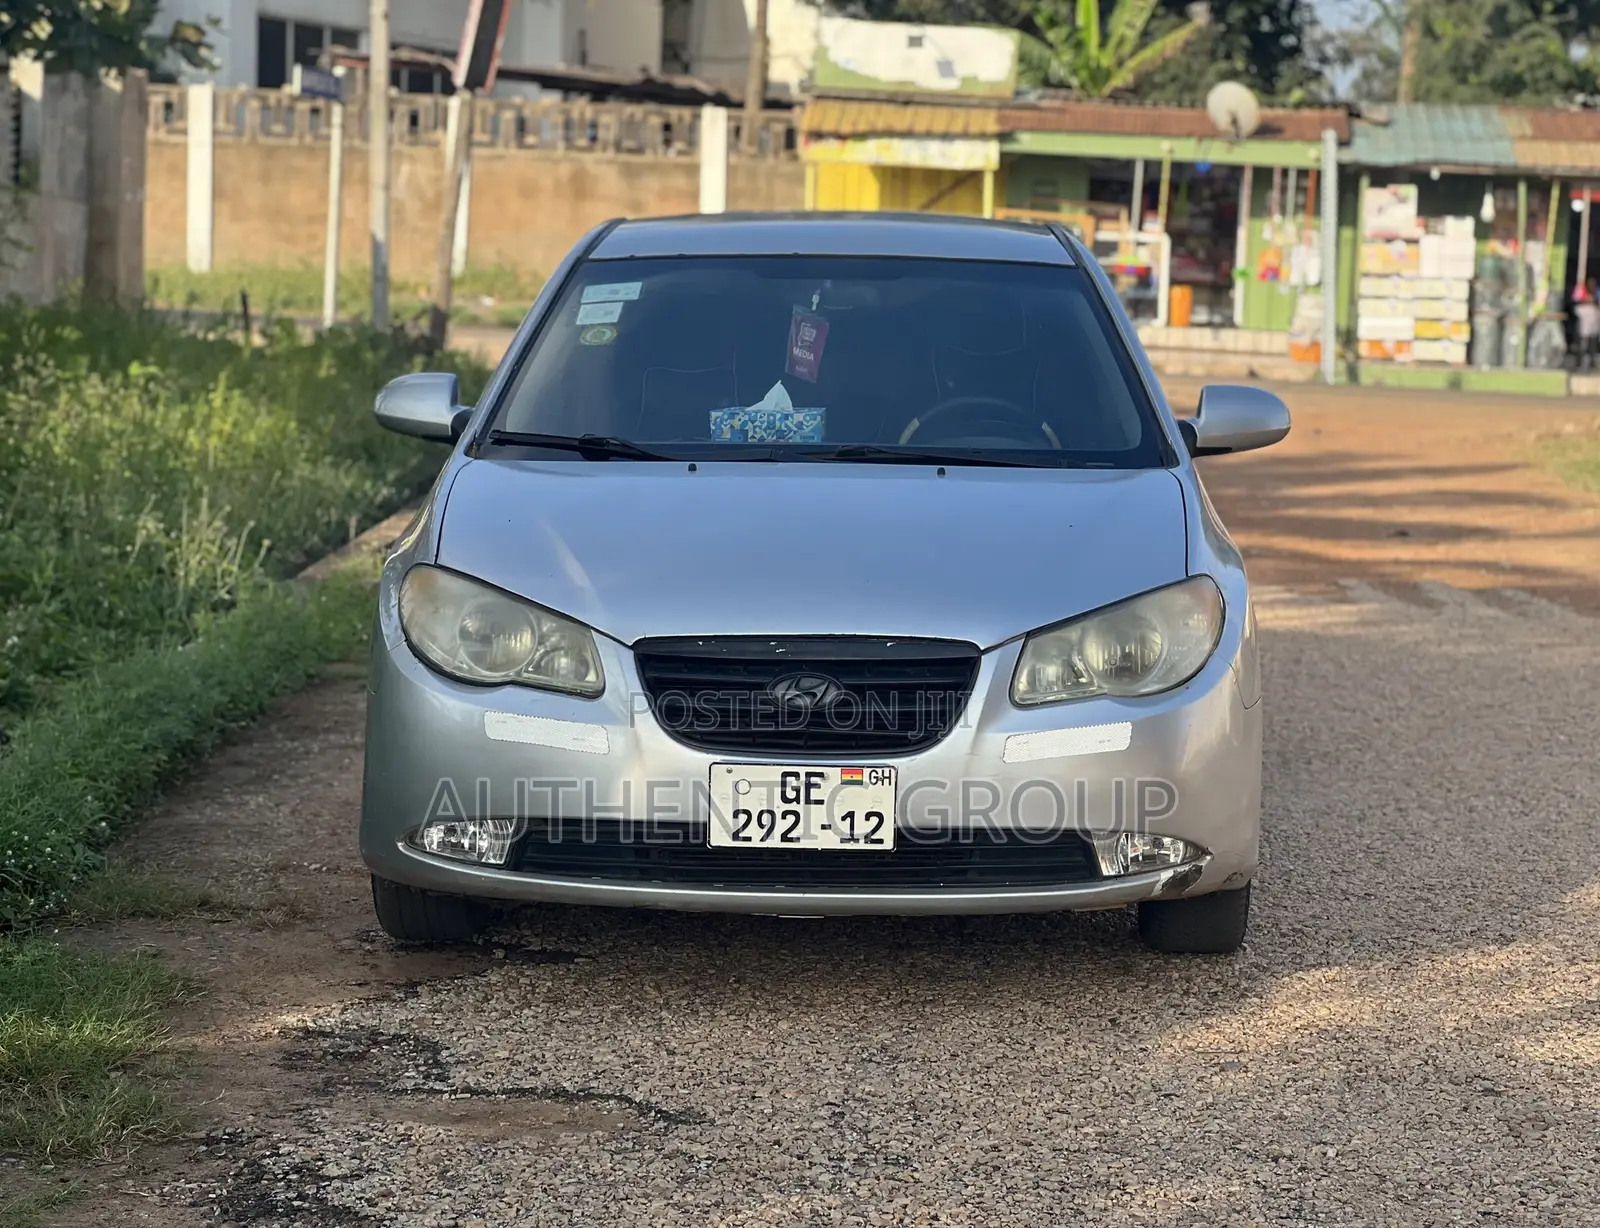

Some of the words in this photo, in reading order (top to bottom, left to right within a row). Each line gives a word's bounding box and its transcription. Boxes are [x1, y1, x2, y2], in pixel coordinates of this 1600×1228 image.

[793, 347, 814, 361] MEDIA
[868, 769, 892, 786] GH
[780, 770, 825, 806] GE
